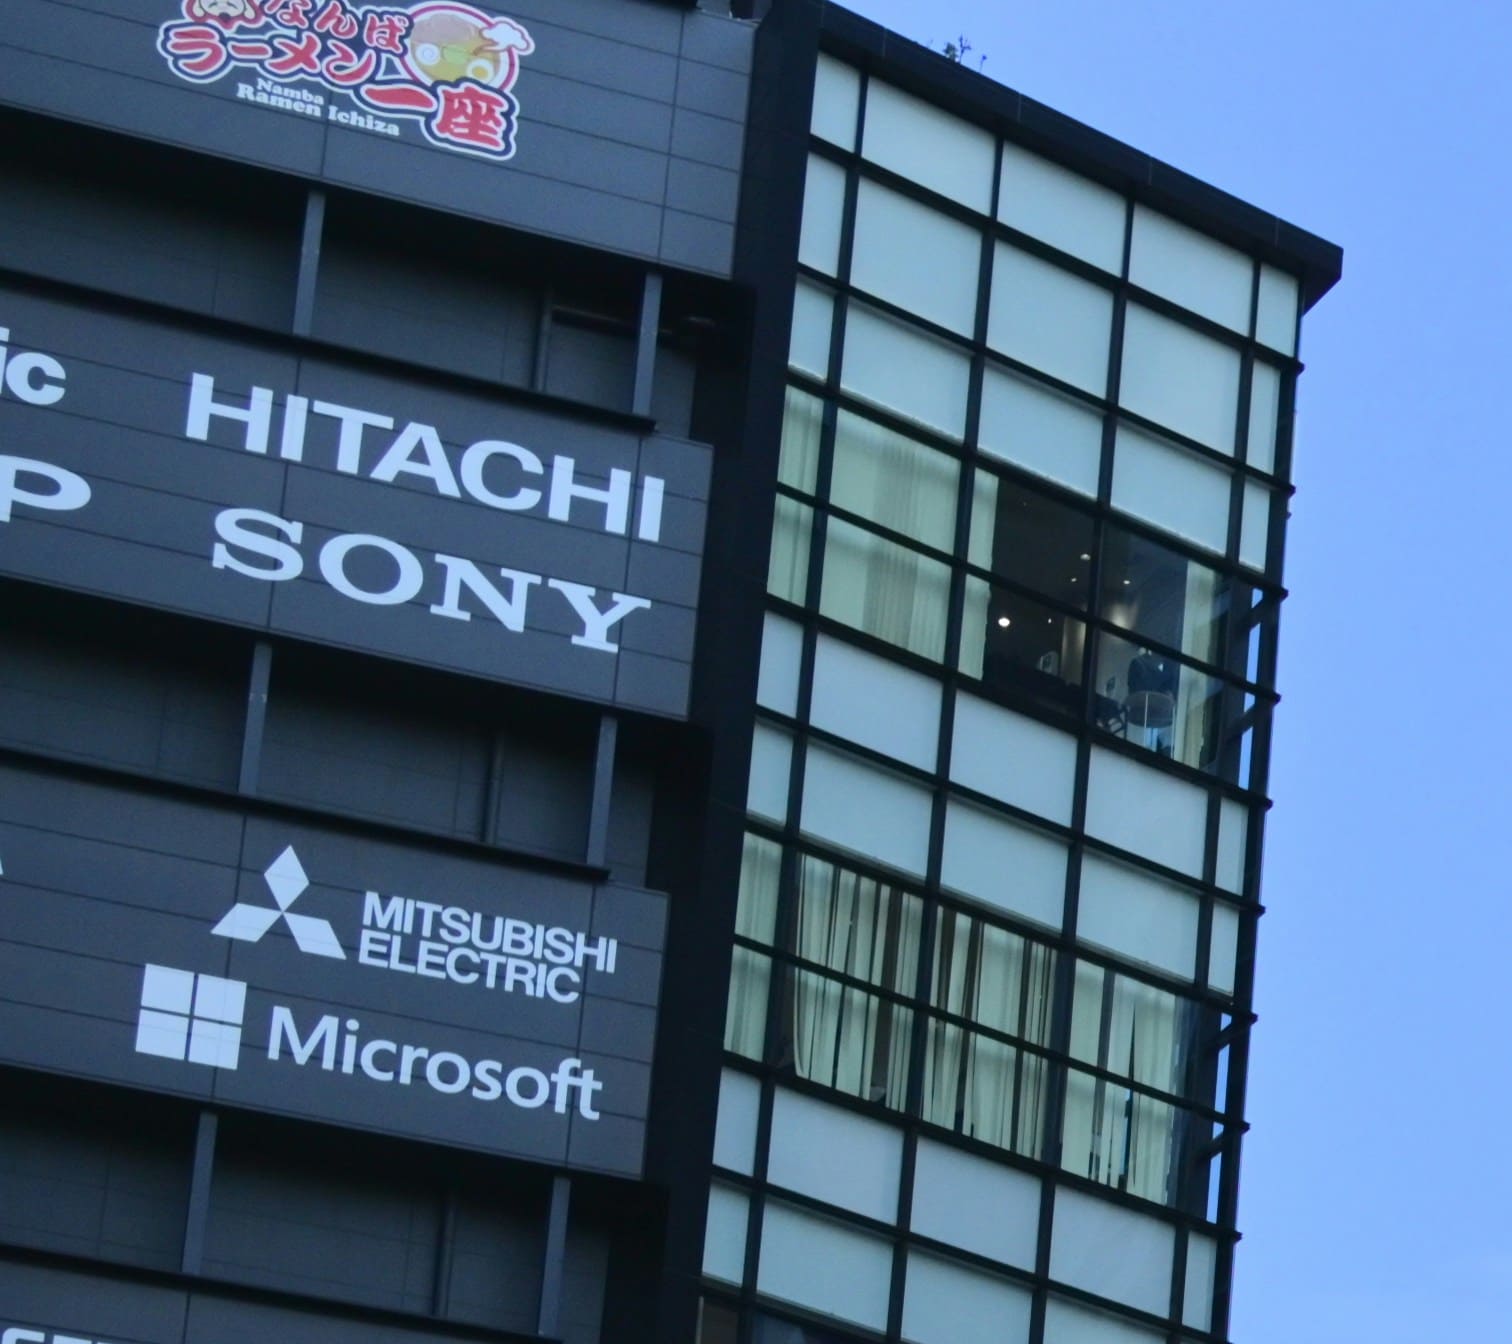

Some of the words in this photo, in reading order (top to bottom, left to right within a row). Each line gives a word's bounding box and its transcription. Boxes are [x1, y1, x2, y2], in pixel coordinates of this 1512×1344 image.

[165, 28, 378, 84] ラーメン
[257, 77, 325, 106] Namba
[236, 82, 322, 118] Ramen
[327, 104, 400, 137] Ichiza
[360, 82, 508, 150] 一座
[186, 373, 665, 542] HITACHI
[212, 508, 651, 652] SONY
[358, 928, 581, 1004] ELECTRIC
[362, 891, 618, 975] MITSUBISHI
[267, 1005, 603, 1120] Microsoft
